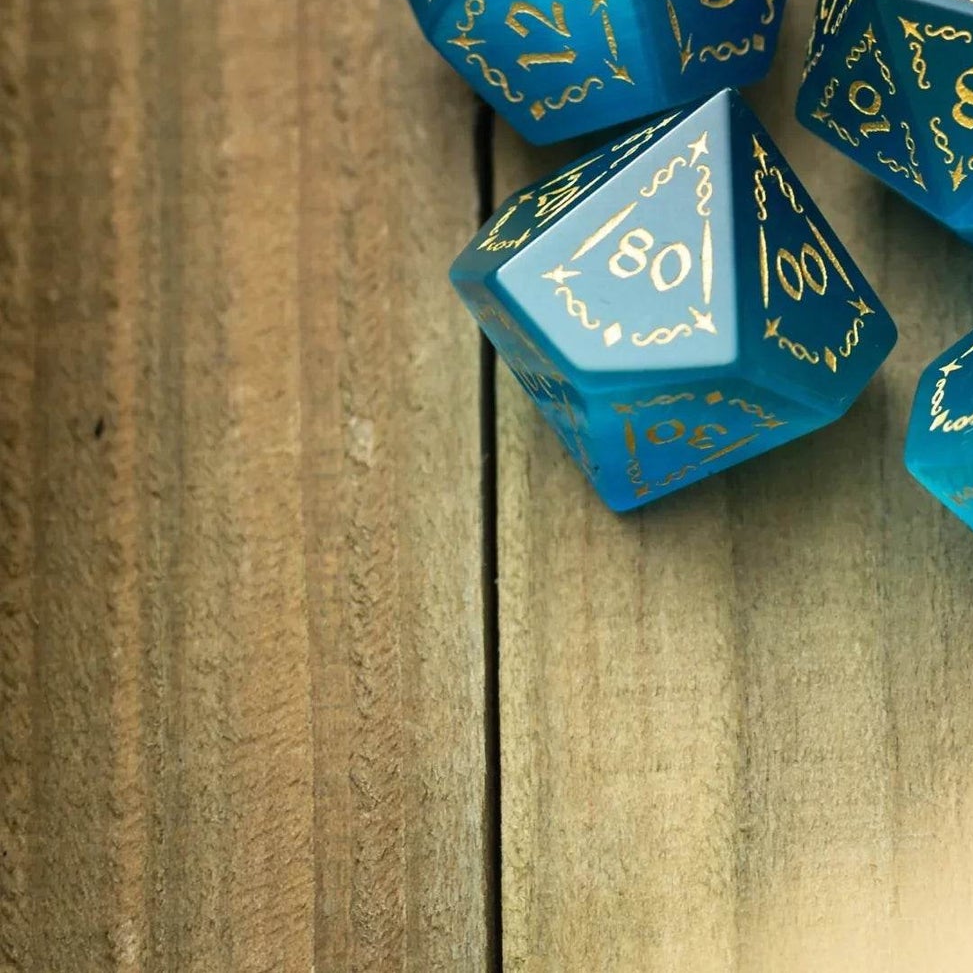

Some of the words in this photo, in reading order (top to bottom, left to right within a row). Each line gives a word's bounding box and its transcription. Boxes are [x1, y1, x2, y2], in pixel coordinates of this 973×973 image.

[504, 0, 578, 72] 12
[847, 78, 892, 139] 10
[607, 226, 693, 294] 80
[775, 242, 829, 302] 00
